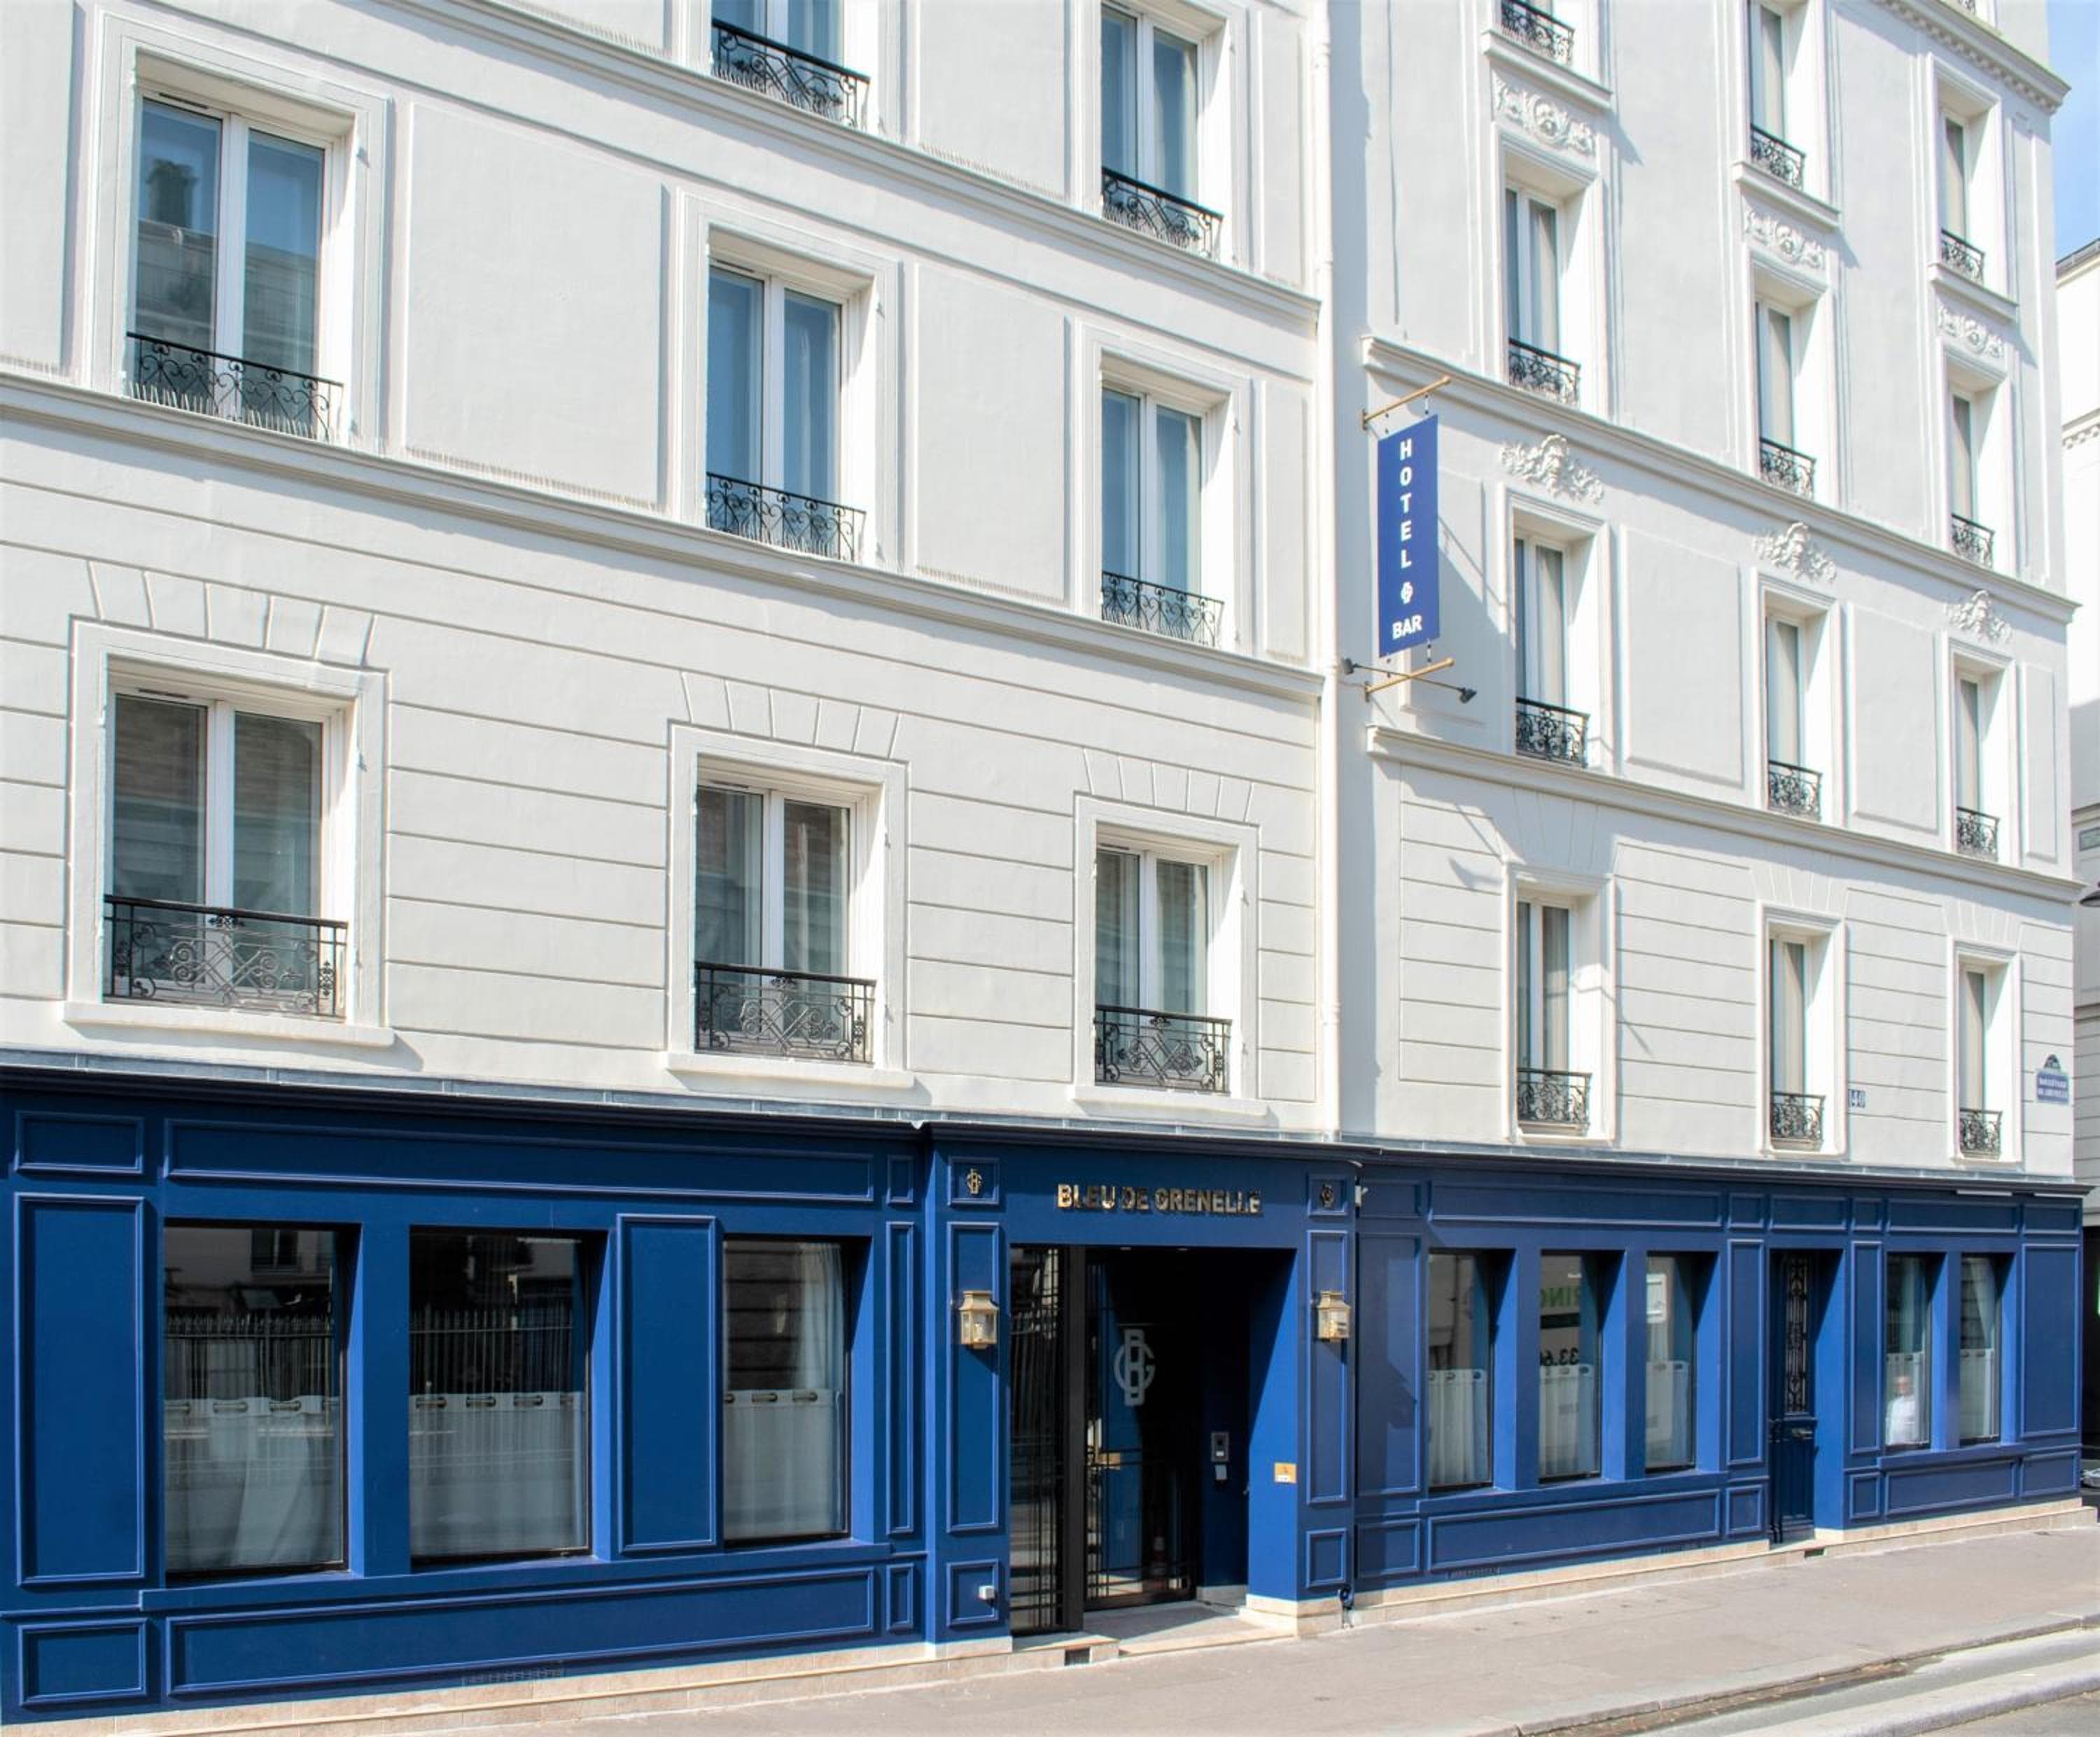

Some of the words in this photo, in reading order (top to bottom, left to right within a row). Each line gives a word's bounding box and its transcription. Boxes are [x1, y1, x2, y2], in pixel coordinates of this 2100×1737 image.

[1400, 438, 1412, 568] HOTEL
[1392, 614, 1422, 640] BAR
[1057, 1183, 1116, 1209] BLEU
[1121, 1186, 1149, 1210] DE
[1154, 1188, 1261, 1214] GRENELLE
